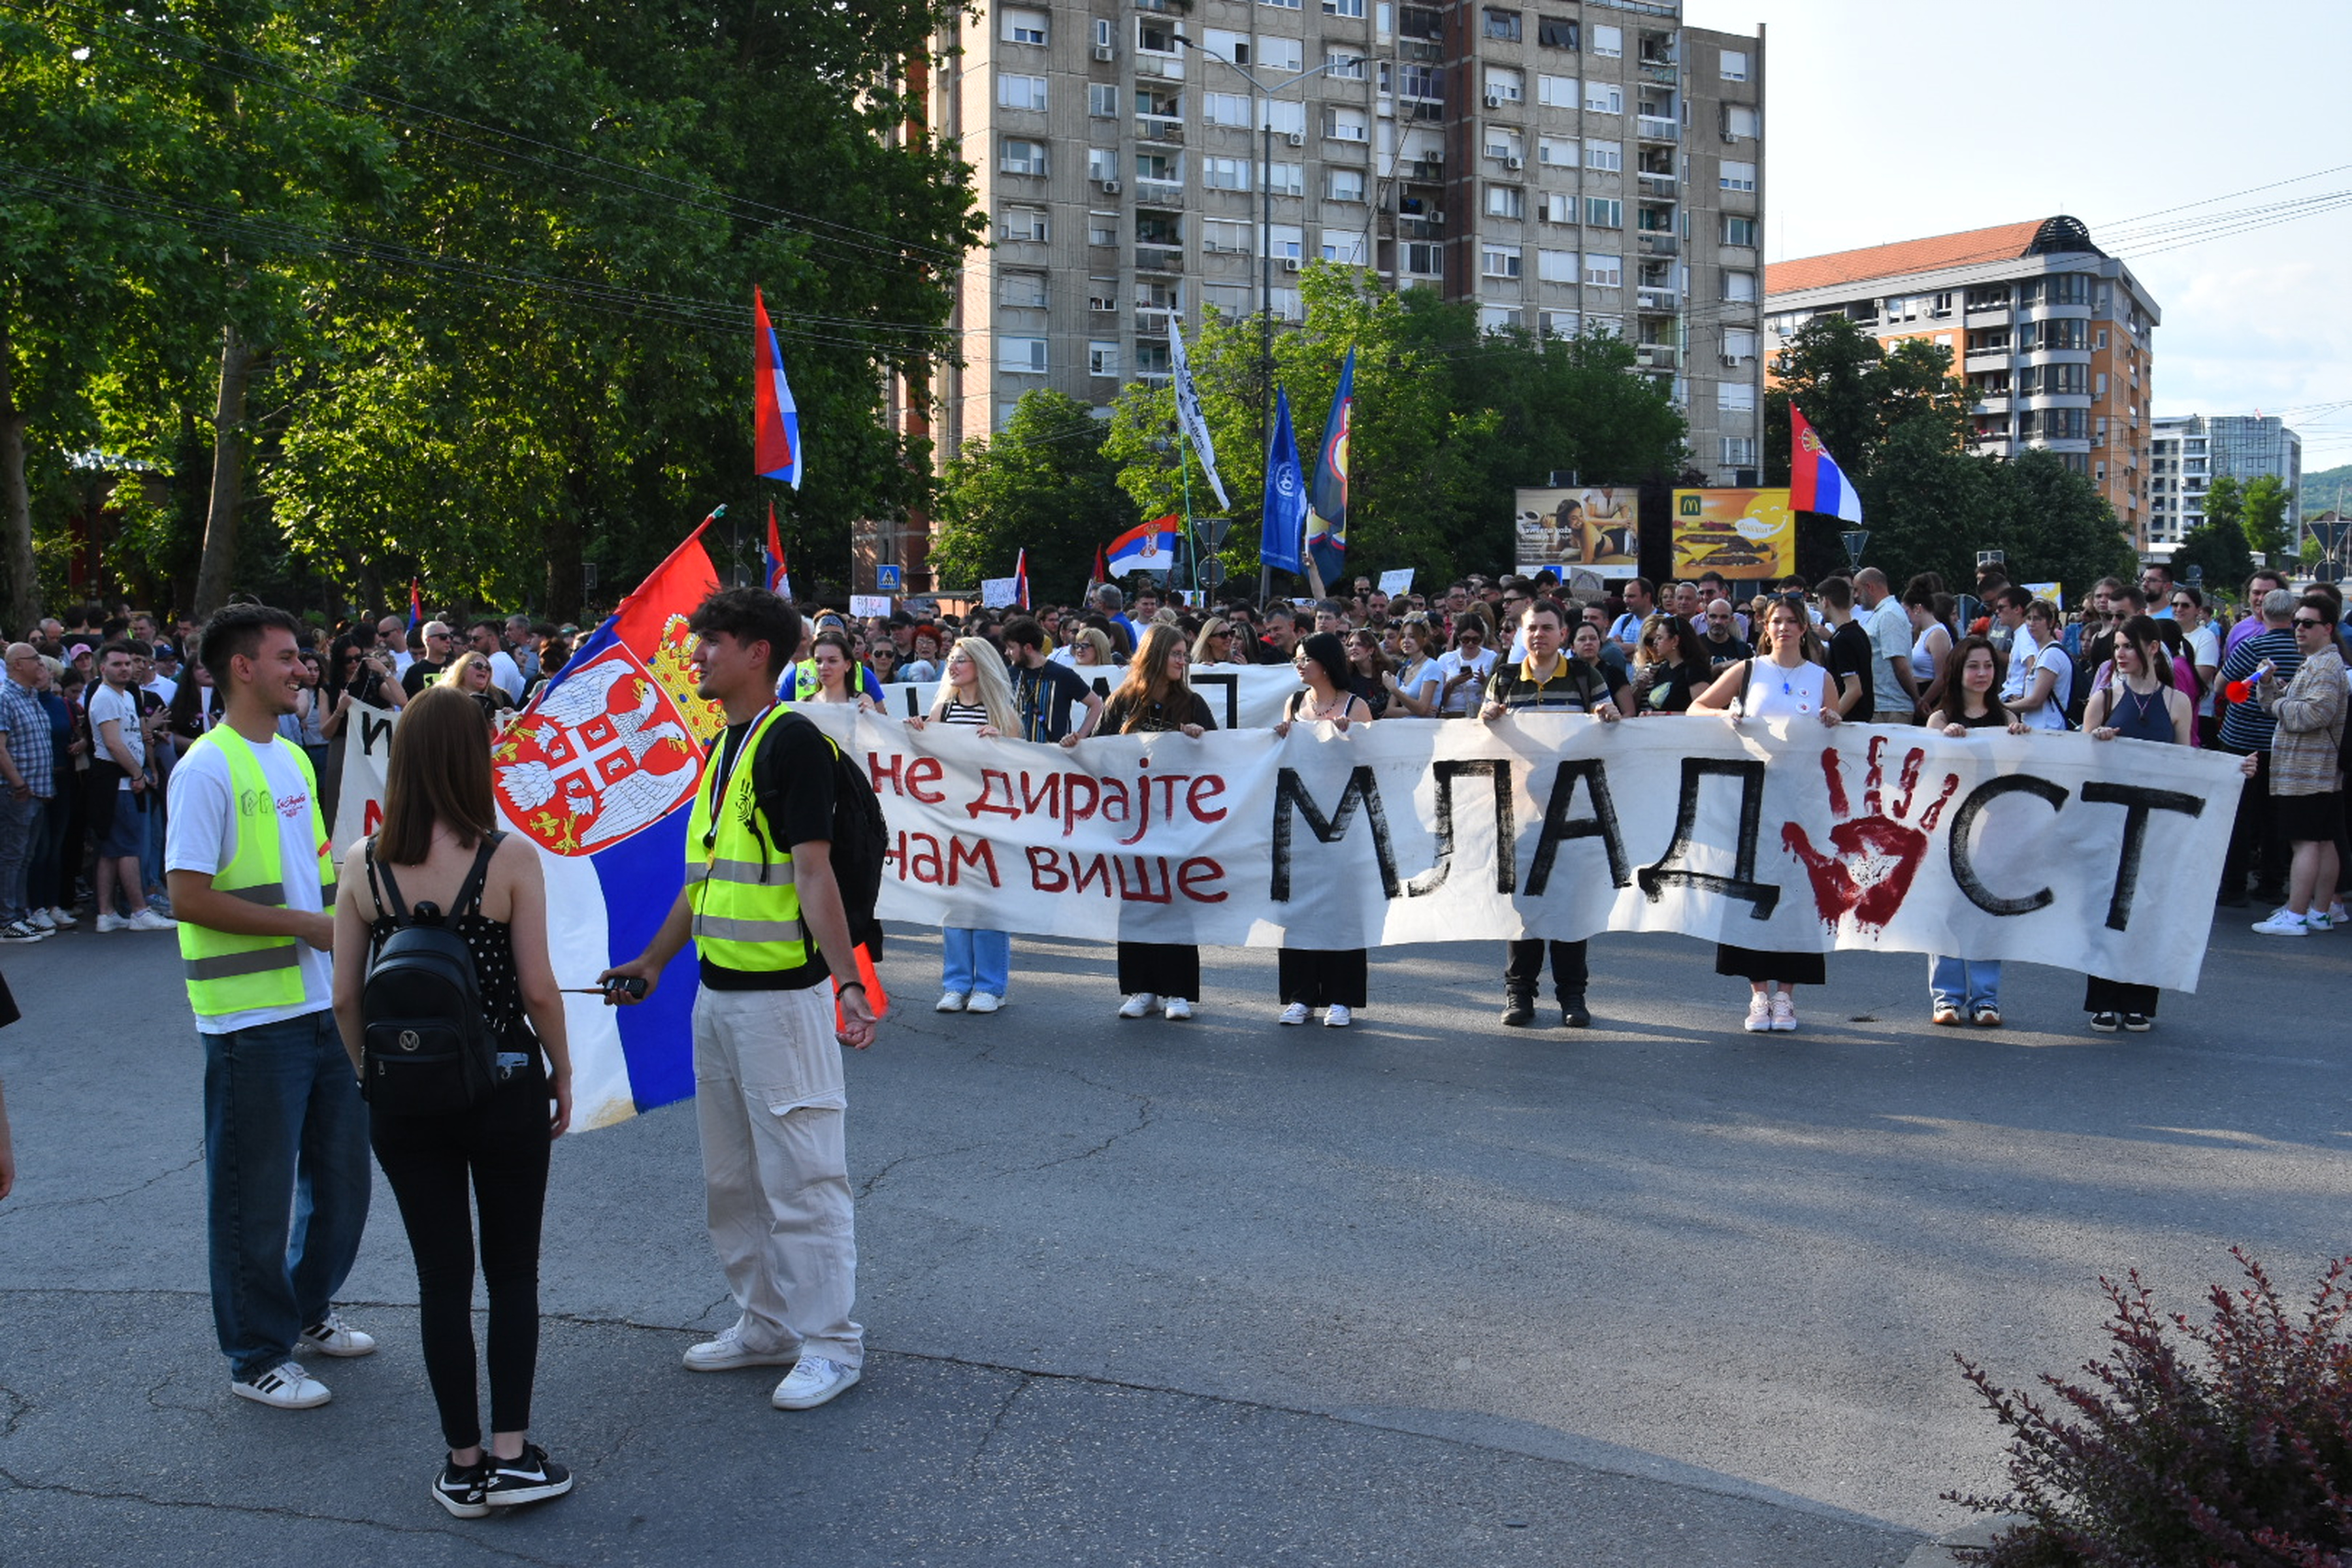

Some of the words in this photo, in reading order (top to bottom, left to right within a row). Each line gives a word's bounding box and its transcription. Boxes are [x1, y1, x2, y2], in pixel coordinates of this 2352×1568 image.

[868, 752, 946, 804] не
[966, 758, 1228, 845] дирајте
[1025, 846, 1229, 904] више
